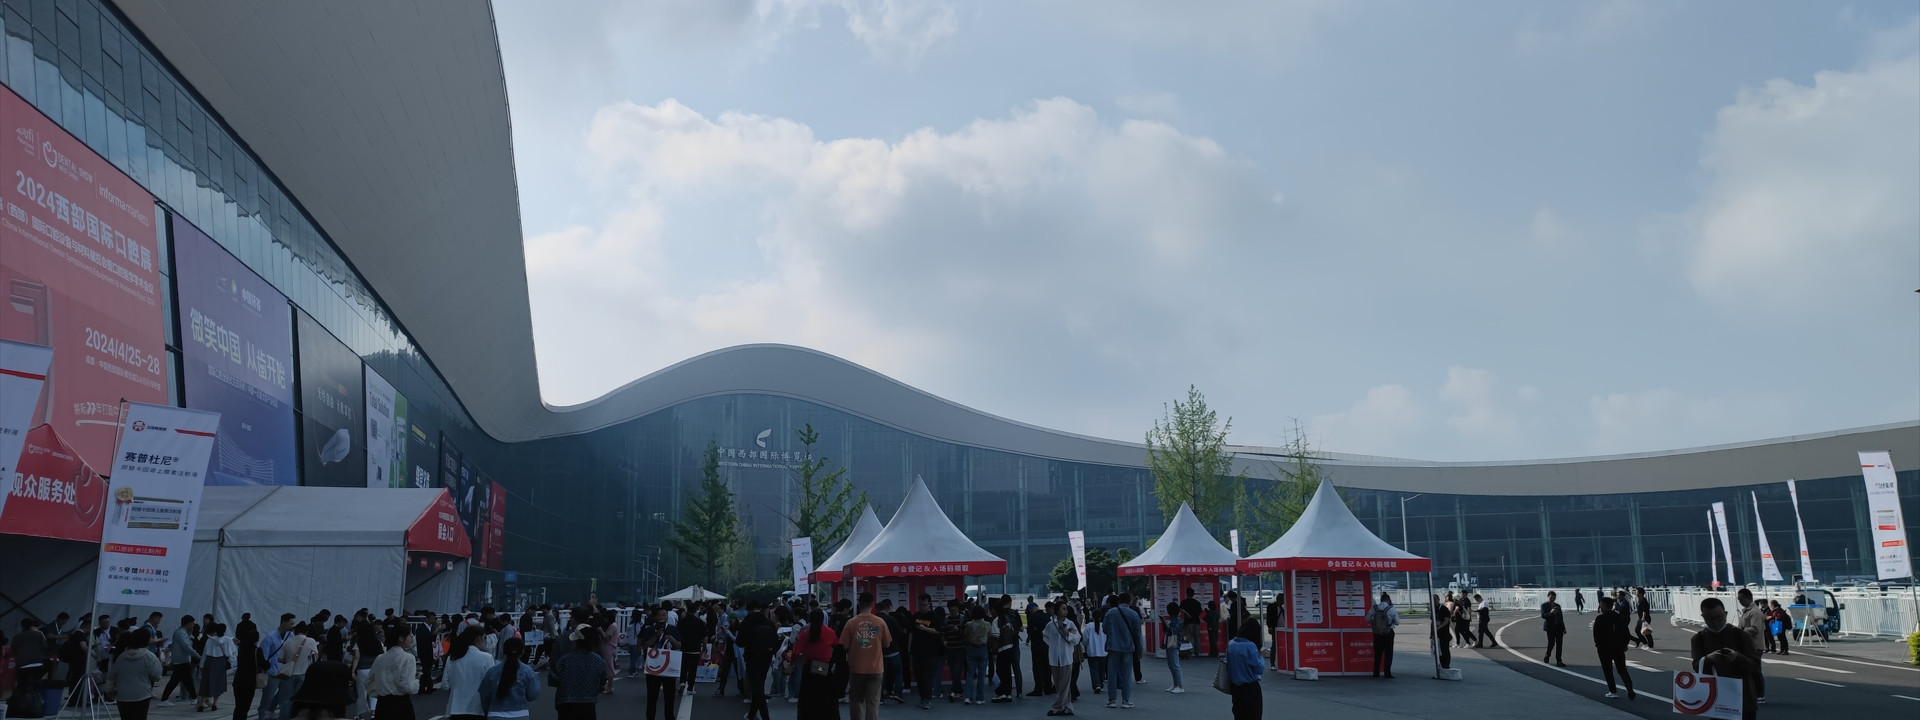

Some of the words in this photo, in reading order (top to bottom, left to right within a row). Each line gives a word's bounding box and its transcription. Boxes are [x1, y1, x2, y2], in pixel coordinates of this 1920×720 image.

[16, 169, 152, 273] 2024西部国际口腔展
[85, 327, 160, 375] 2024/4/25-28
[190, 307, 242, 365] 微笑中国
[246, 340, 286, 390] 从齿开始
[437, 523, 454, 542] 展会入口
[118, 567, 170, 576] 5号馆M33展位
[856, 631, 876, 639] NIKE
